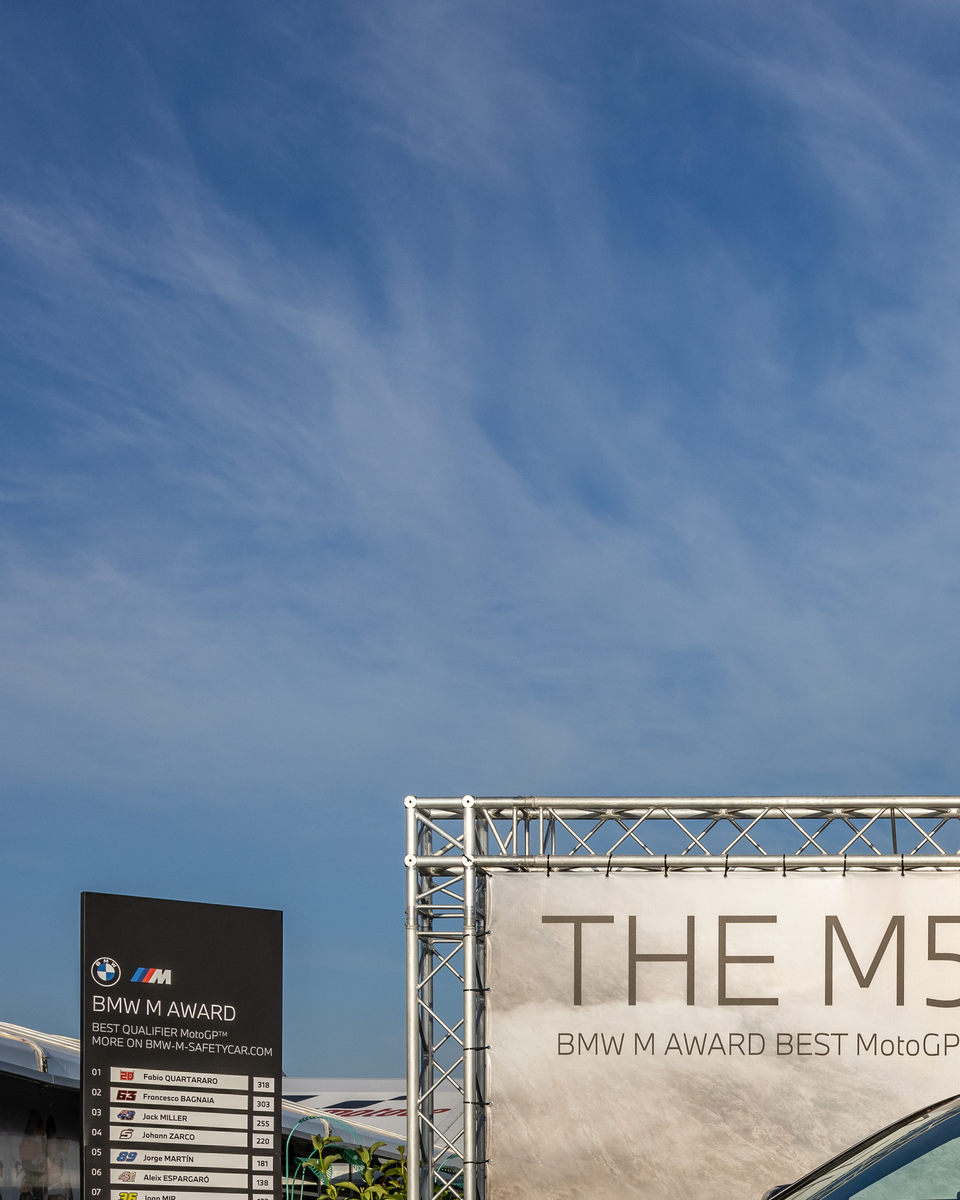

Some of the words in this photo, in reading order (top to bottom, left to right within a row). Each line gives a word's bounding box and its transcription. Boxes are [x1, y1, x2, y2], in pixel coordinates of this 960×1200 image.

[541, 915, 779, 1006] THE
[92, 995, 140, 1015] BMW
[146, 1000, 162, 1016] M
[167, 1001, 236, 1022] AWARD
[92, 1022, 120, 1034] BEST
[122, 1024, 178, 1038] QUALIFIER
[92, 1036, 124, 1048] MORE
[126, 1038, 143, 1048] ON
[145, 1040, 273, 1057] BMW-M-SAFETYCAR.COM
[557, 1033, 624, 1056] BMW
[634, 1033, 656, 1056] M
[664, 1033, 766, 1056] AWARD
[777, 1033, 848, 1056] BEST
[91, 1068, 101, 1076] 01
[143, 1073, 164, 1082] Fabio
[165, 1075, 219, 1085] QUARTARARO
[257, 1081, 270, 1089] 318
[91, 1088, 102, 1097] 02
[116, 1090, 137, 1101] 63
[143, 1093, 179, 1102] Francesco
[180, 1095, 215, 1104] BAGNAIA
[256, 1100, 271, 1108] 303
[91, 1108, 102, 1117] 03
[142, 1113, 159, 1121] Jack
[256, 1120, 270, 1128] 255
[91, 1128, 102, 1137] 04
[142, 1131, 168, 1140] Johann
[169, 1133, 196, 1141] ZARCO
[91, 1148, 102, 1156] 05
[116, 1151, 138, 1163] 89
[143, 1154, 163, 1163] Jorge
[164, 1155, 195, 1163] MARTÍN
[91, 1168, 102, 1177] 06
[143, 1173, 162, 1181] Aleix
[163, 1174, 210, 1184] ESPARGARÓ
[256, 1179, 269, 1187] 138
[91, 1188, 102, 1196] 07
